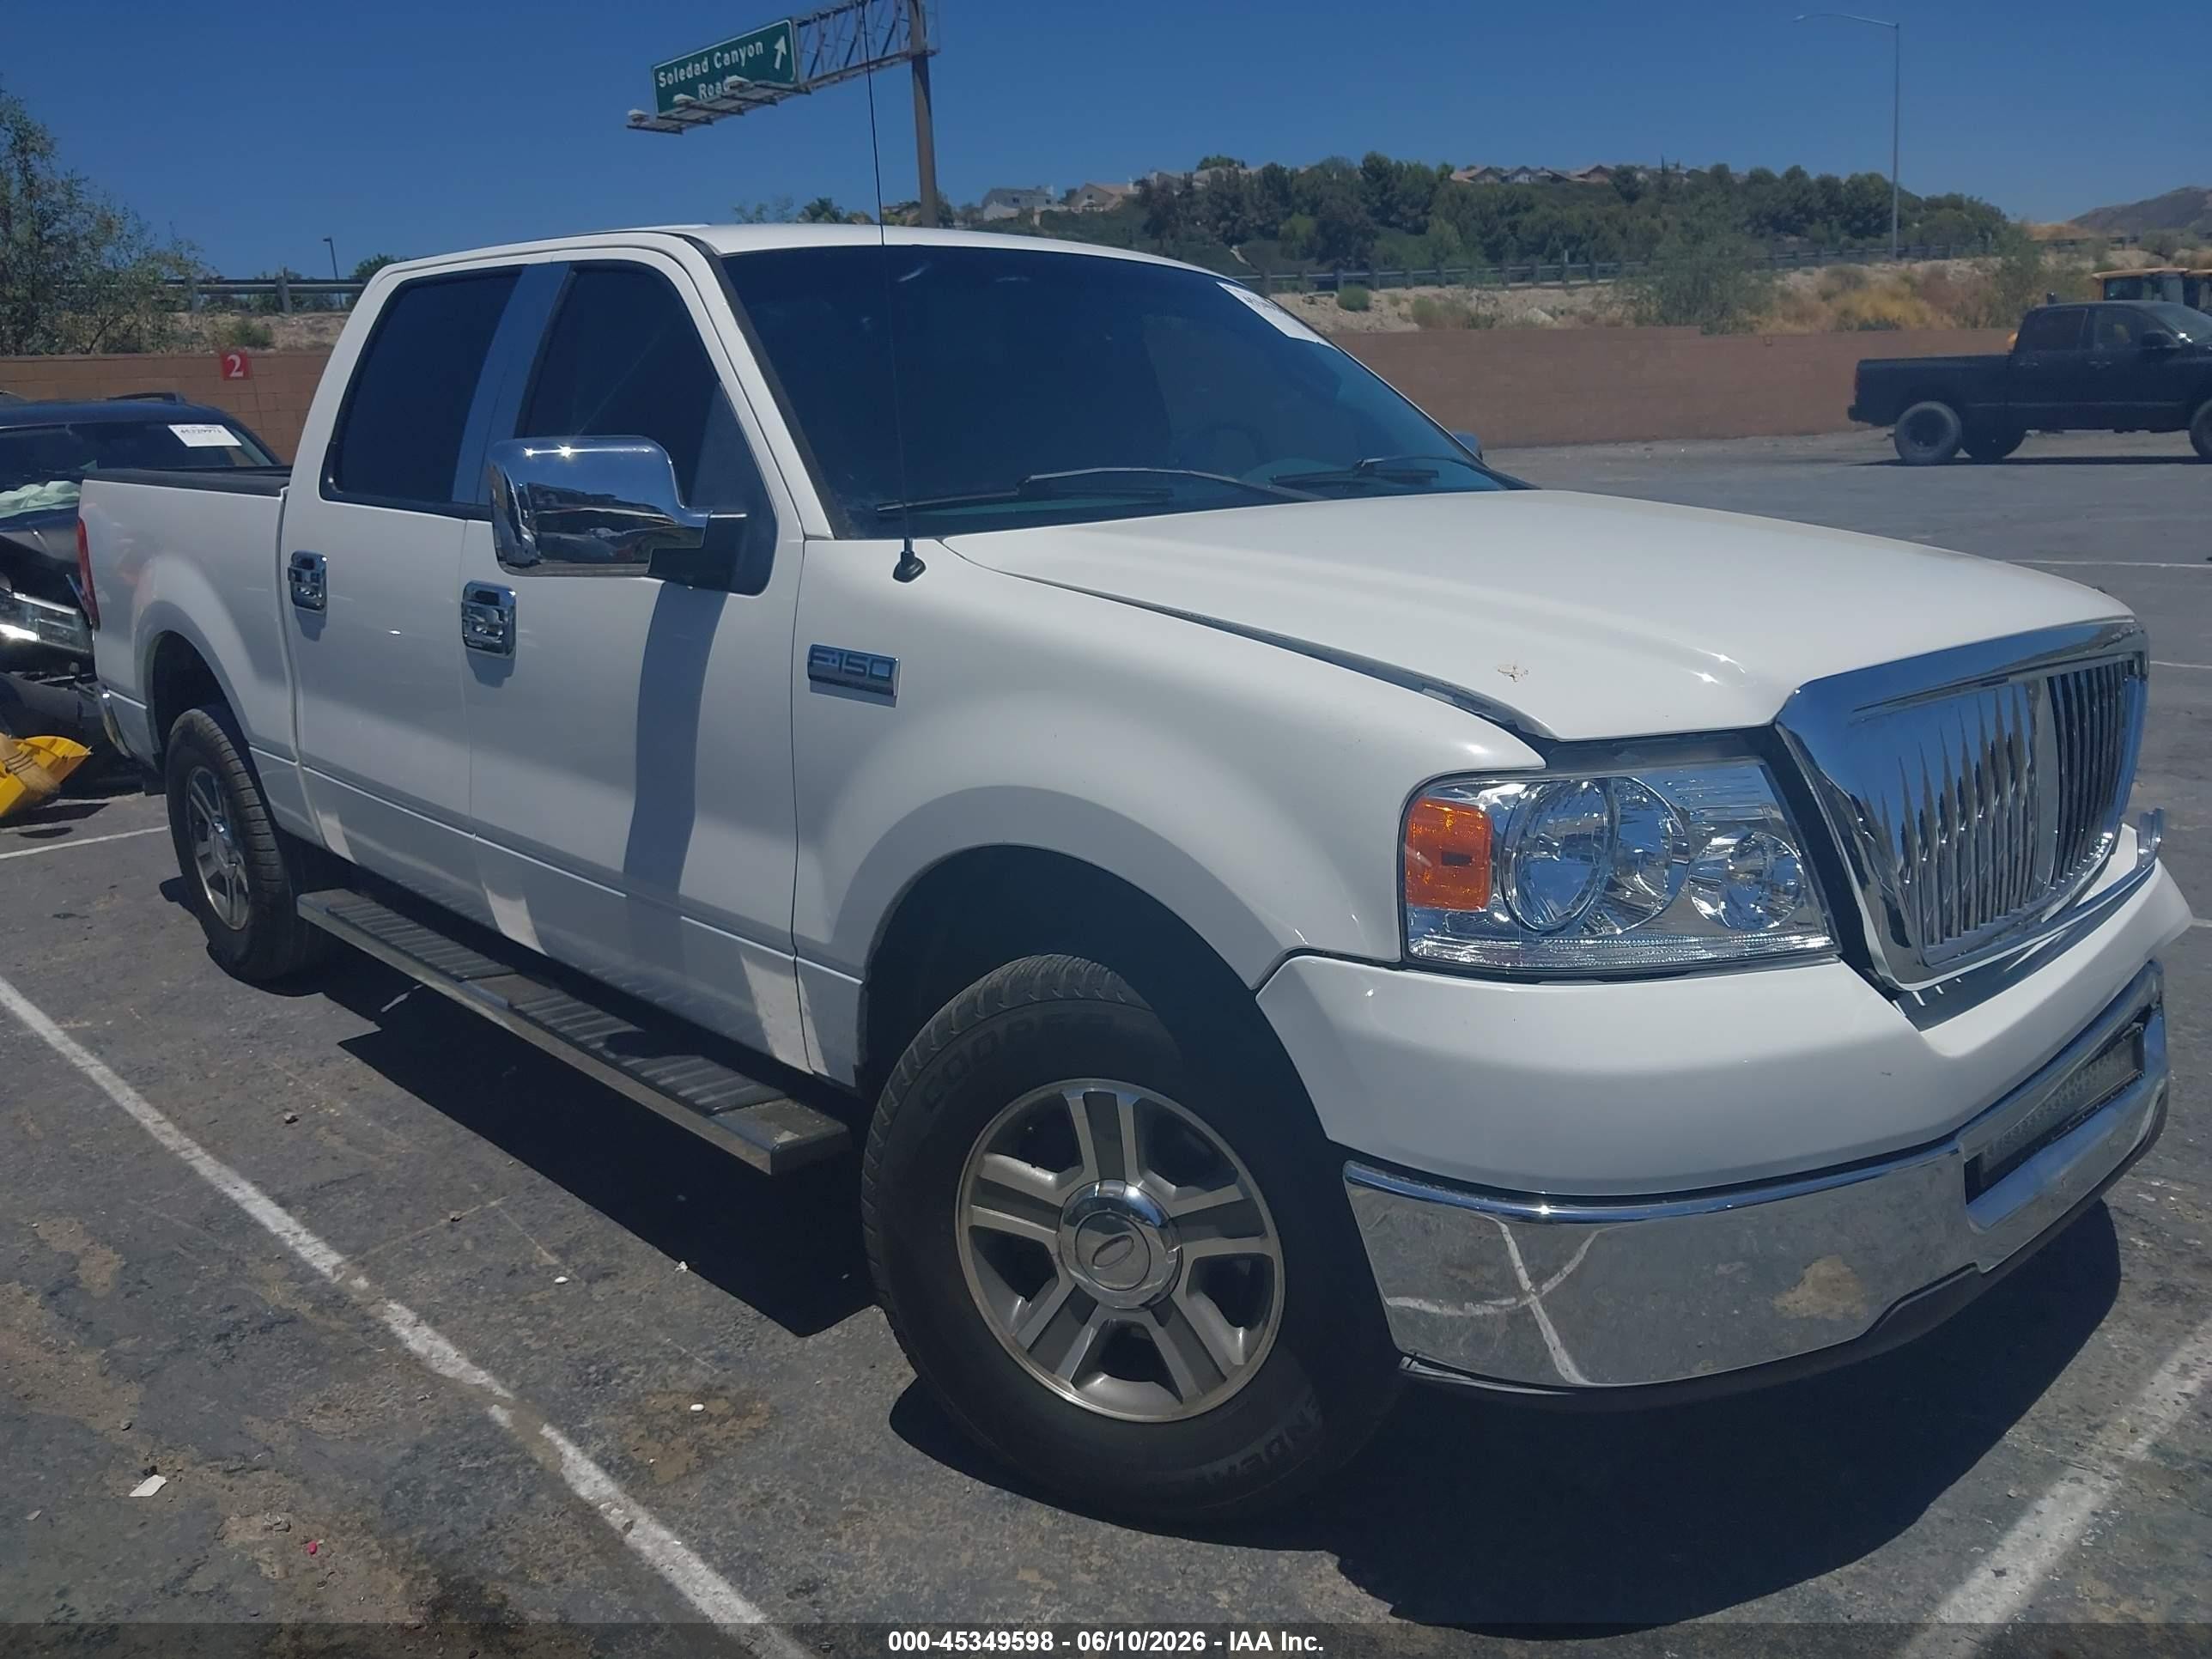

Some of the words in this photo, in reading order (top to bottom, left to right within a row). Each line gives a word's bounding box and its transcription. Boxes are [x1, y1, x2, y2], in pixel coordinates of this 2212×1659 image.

[658, 57, 709, 88] Soledad
[713, 41, 763, 69] Canyon
[227, 354, 244, 378] 2
[809, 645, 896, 684] F-150
